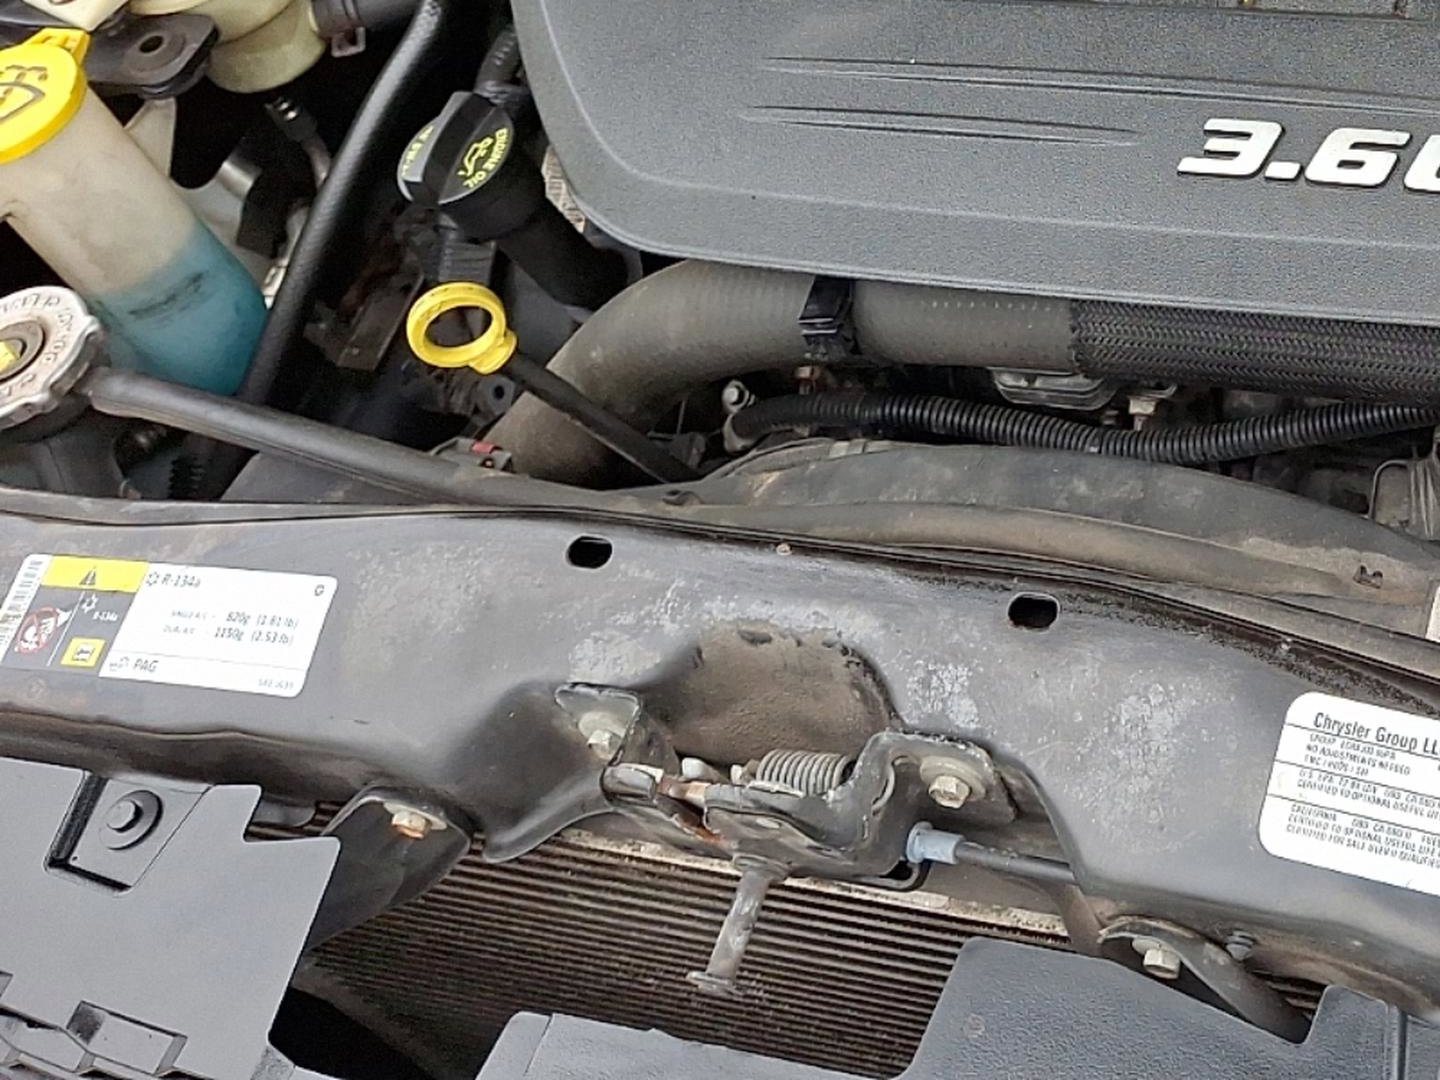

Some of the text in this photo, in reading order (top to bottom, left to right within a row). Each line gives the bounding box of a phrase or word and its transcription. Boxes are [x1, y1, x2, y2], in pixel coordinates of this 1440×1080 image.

[462, 170, 487, 188] OIL
[1314, 712, 1370, 738] Chrysler
[1375, 726, 1418, 751] Group
